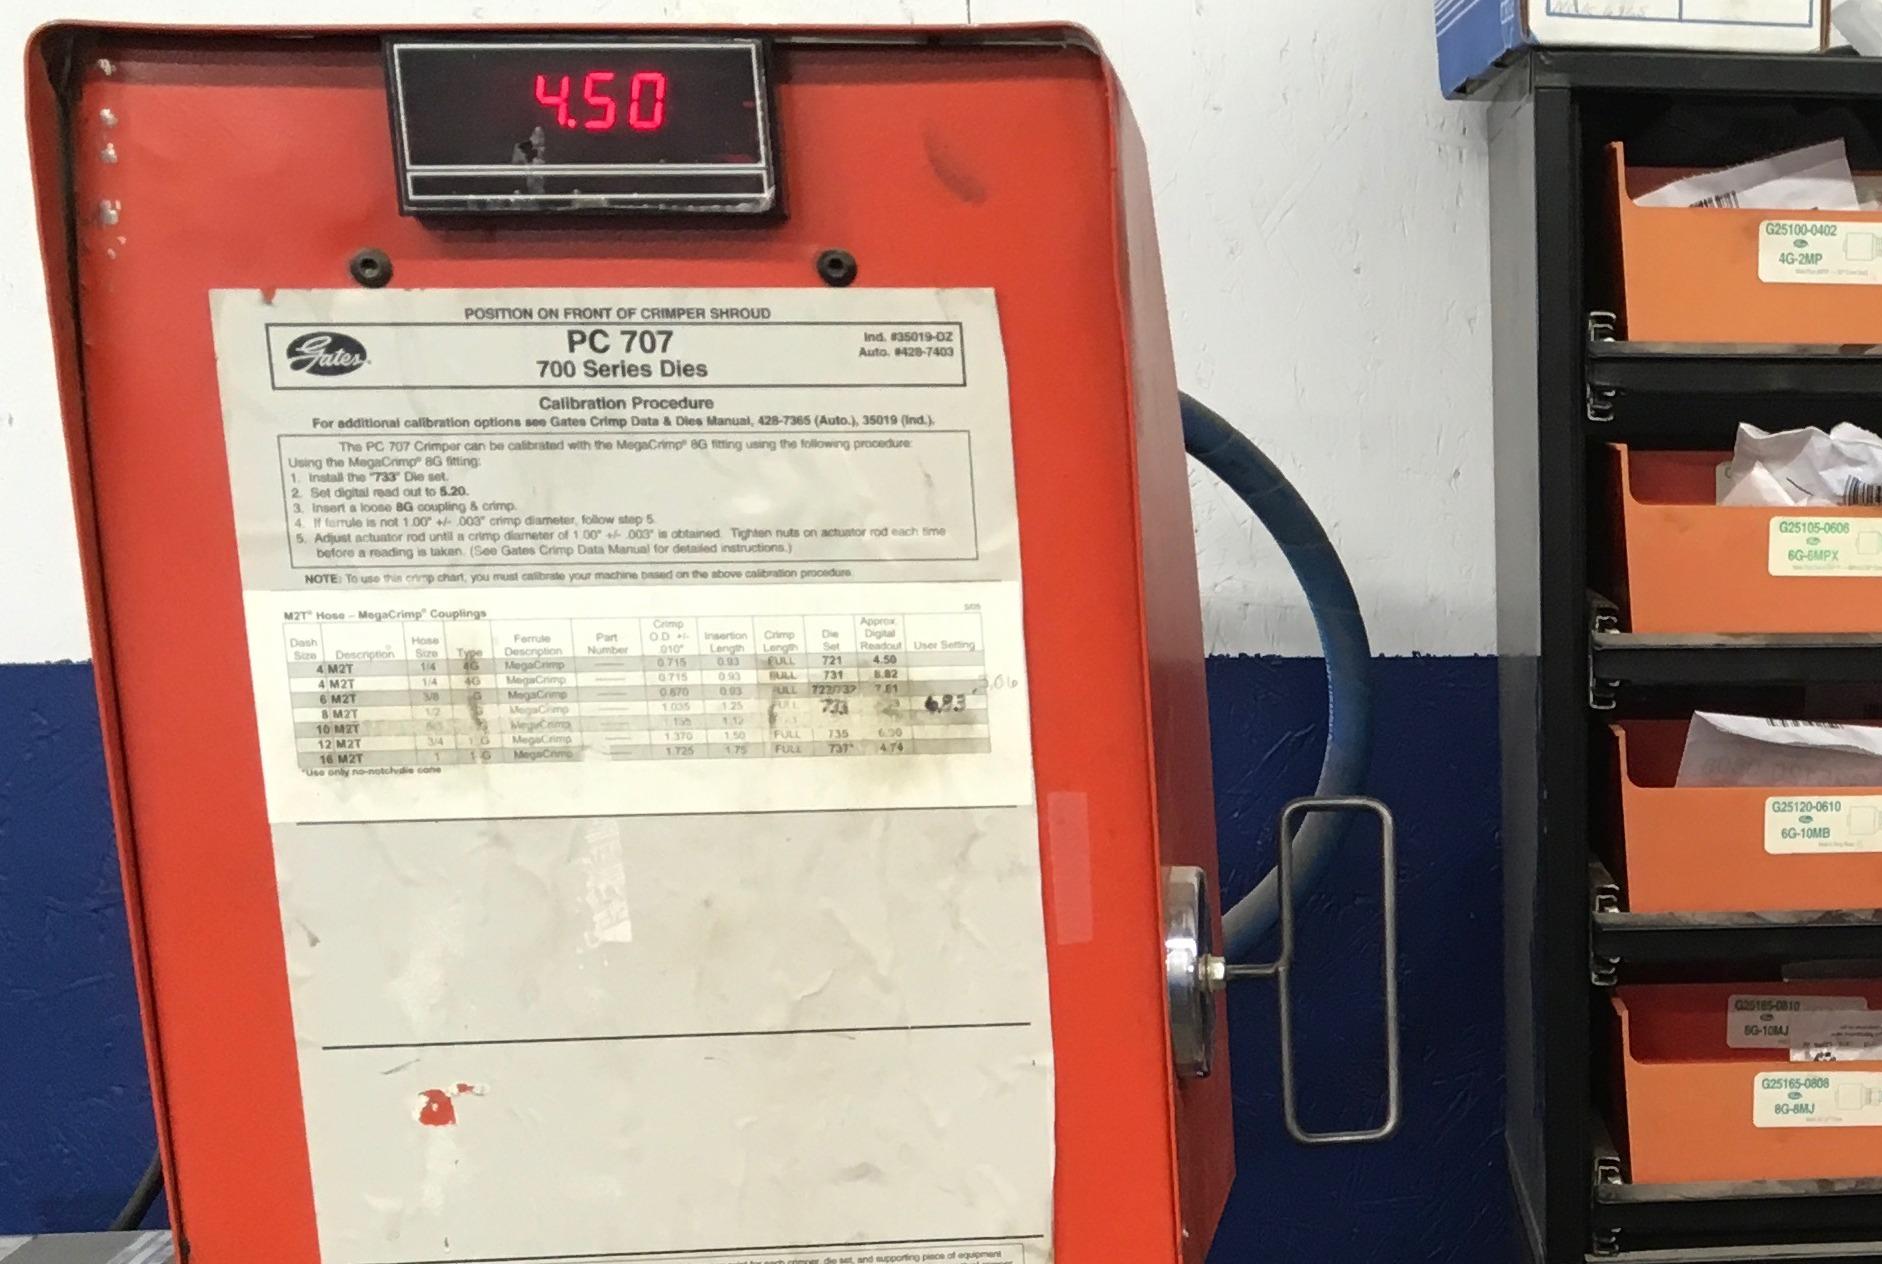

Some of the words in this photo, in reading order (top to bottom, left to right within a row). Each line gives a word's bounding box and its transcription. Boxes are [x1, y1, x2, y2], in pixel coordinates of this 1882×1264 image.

[534, 71, 667, 131] 4.50
[1766, 223, 1837, 237] G25100-0402
[1779, 252, 1822, 266] 4G-2MP
[464, 308, 533, 320] POSITION
[537, 308, 559, 320] ON
[564, 308, 611, 320] FRONT
[616, 308, 636, 319] OF
[641, 308, 705, 319] CRIMPER
[710, 308, 771, 319] SHROUD
[567, 329, 610, 354] PC
[620, 330, 673, 353] 707
[864, 332, 887, 342] Ind.
[288, 336, 368, 372] Gates
[859, 347, 890, 357] Auto.
[894, 346, 954, 357] #428-7403
[537, 360, 576, 378] 700
[583, 360, 652, 378] Series
[660, 360, 708, 377] Dies
[539, 396, 627, 410] Calibration
[632, 396, 714, 410] Procedure
[312, 418, 334, 429] For
[337, 417, 400, 429] additional
[404, 417, 470, 428] calibration
[473, 417, 521, 430] options
[525, 418, 546, 427] see
[550, 416, 586, 427] Gates
[590, 416, 627, 429] Crimp
[631, 416, 659, 426] Data
[663, 416, 671, 426] &
[676, 415, 703, 426] Dies
[707, 415, 754, 427] Manual,
[758, 415, 811, 426] 428-7365
[862, 415, 897, 425] 35019
[309, 472, 344, 482] Install
[347, 472, 366, 482] the
[404, 472, 425, 482] Die
[428, 472, 449, 482] set.
[311, 487, 331, 498] Set
[334, 487, 369, 499] digital
[373, 487, 399, 497] read
[403, 488, 422, 497] out
[425, 487, 436, 497] to
[440, 486, 469, 497] 5.20.
[316, 611, 345, 620] Hose
[430, 608, 487, 620] Couplings
[913, 640, 938, 650] User
[941, 640, 975, 651] Setting
[822, 655, 842, 665] 721
[873, 655, 897, 665] 4.50
[824, 670, 843, 679] 731
[1772, 800, 1841, 814] G25120-0610
[1781, 827, 1831, 841] 6G-10MB
[1762, 1077, 1829, 1091] G25165-0808
[1774, 1103, 1814, 1116] 8G-8MJ
